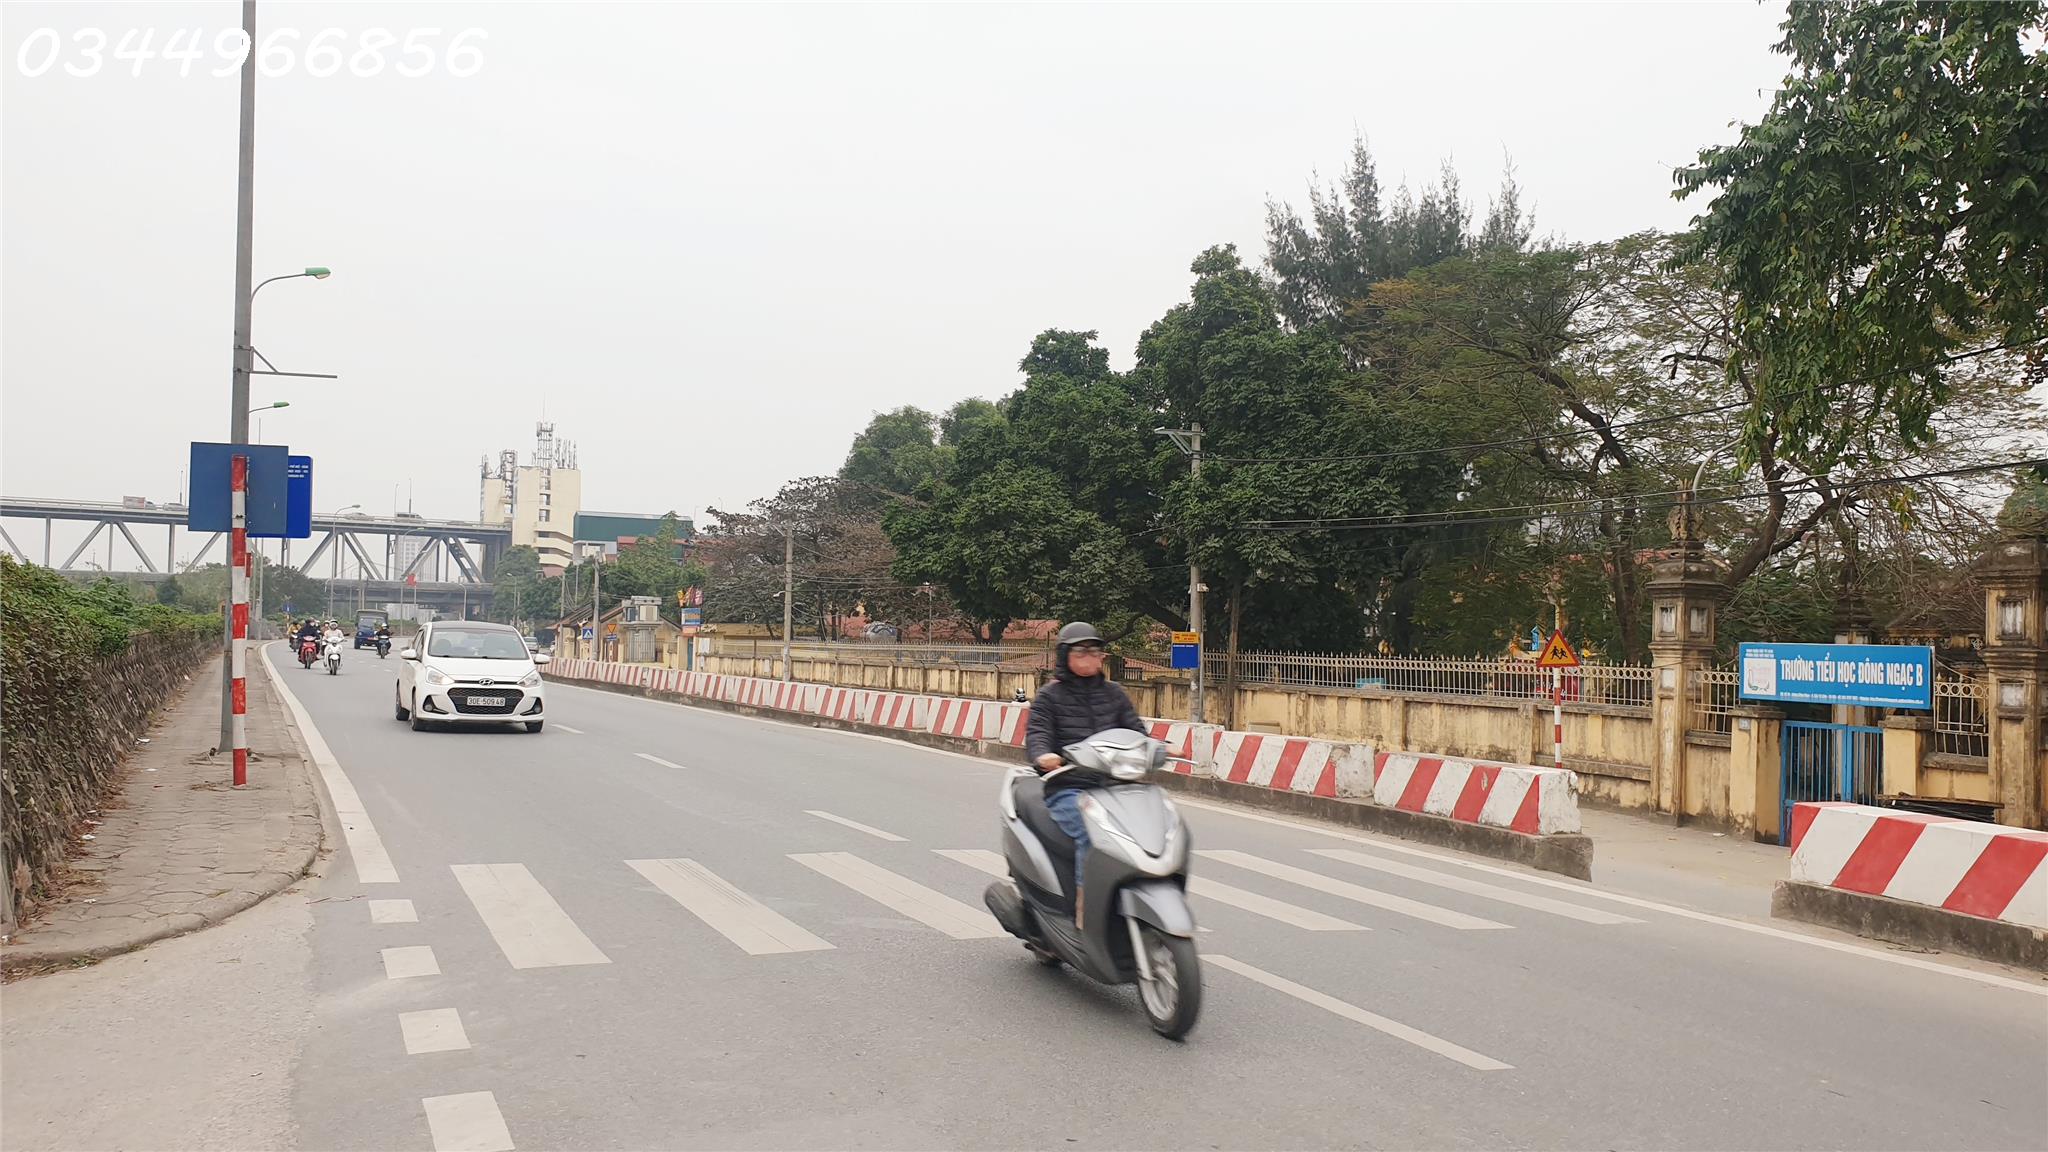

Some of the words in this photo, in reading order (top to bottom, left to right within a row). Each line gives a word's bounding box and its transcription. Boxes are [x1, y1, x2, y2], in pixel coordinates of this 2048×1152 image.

[1780, 655, 1814, 682] TRƯỜNG
[1816, 652, 1835, 683] TIỂU
[1837, 661, 1856, 688] HỌC
[1858, 657, 1884, 685] ĐÔNG
[1887, 663, 1914, 691] NGẠC
[1916, 663, 1923, 686] B
